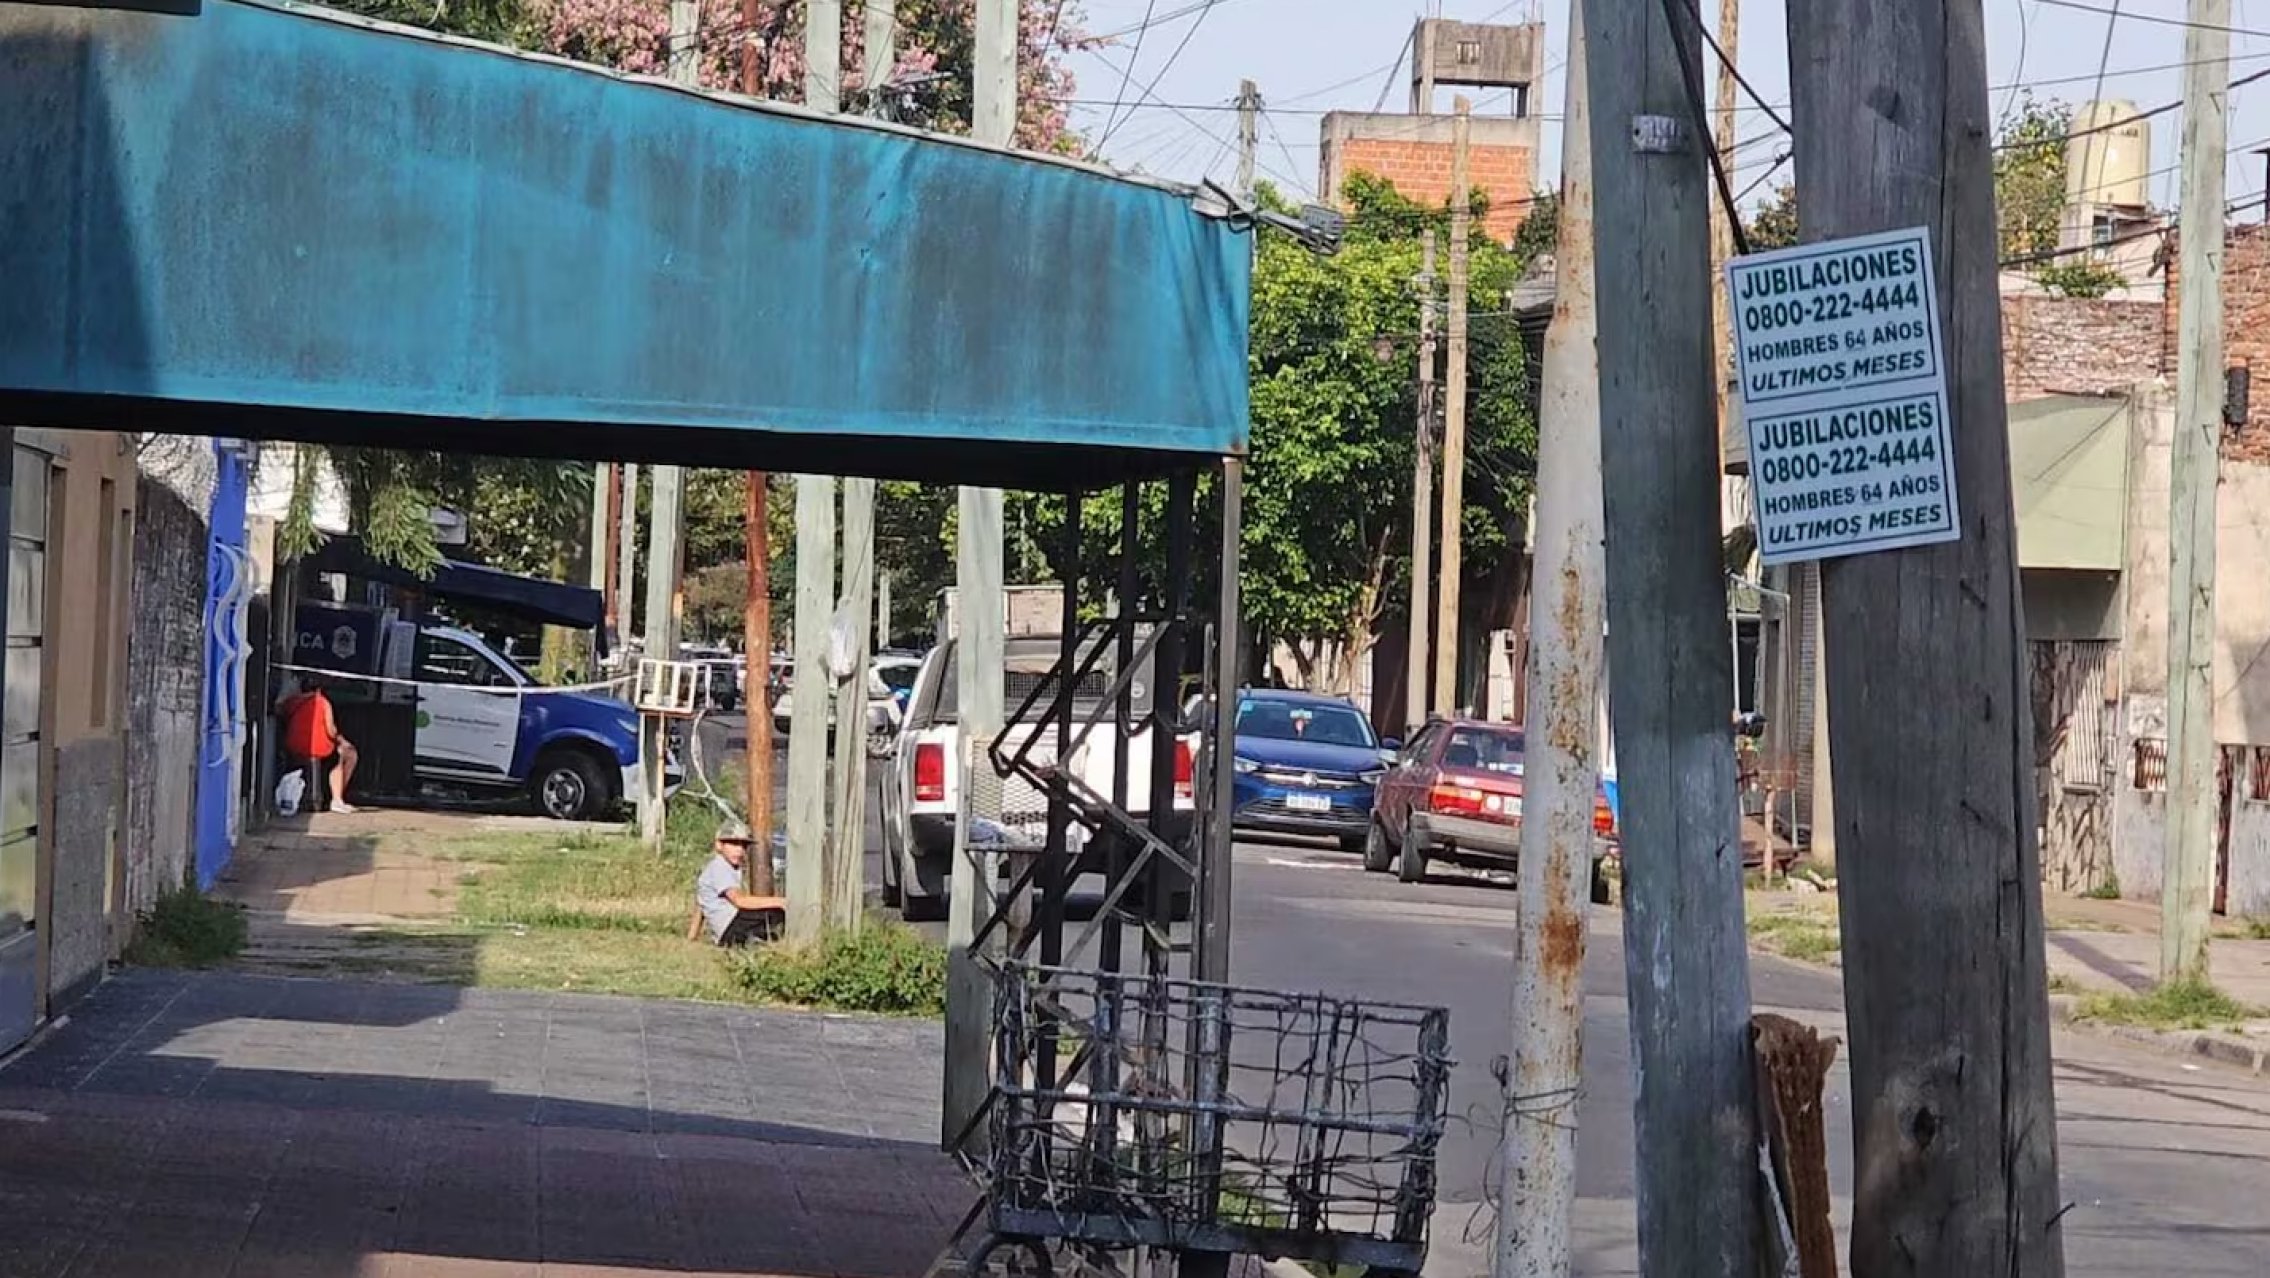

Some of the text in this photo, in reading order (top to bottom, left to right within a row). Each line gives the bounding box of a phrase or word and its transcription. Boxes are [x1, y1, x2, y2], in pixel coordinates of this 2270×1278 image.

[1741, 247, 1917, 300] JUBILACIONES
[1745, 281, 1919, 332] 0800-222-4444
[1747, 320, 1925, 363] HOMBRES 64 AÑOS
[1751, 349, 1925, 393] ULTIMOS MESES
[1758, 401, 1934, 452] JUBILACIONES
[1762, 434, 1936, 485] 0800-222-4444
[1764, 474, 1941, 516] HOMBRES 64 AÑOS
[1769, 503, 1942, 545] ULTIMOS MESES
